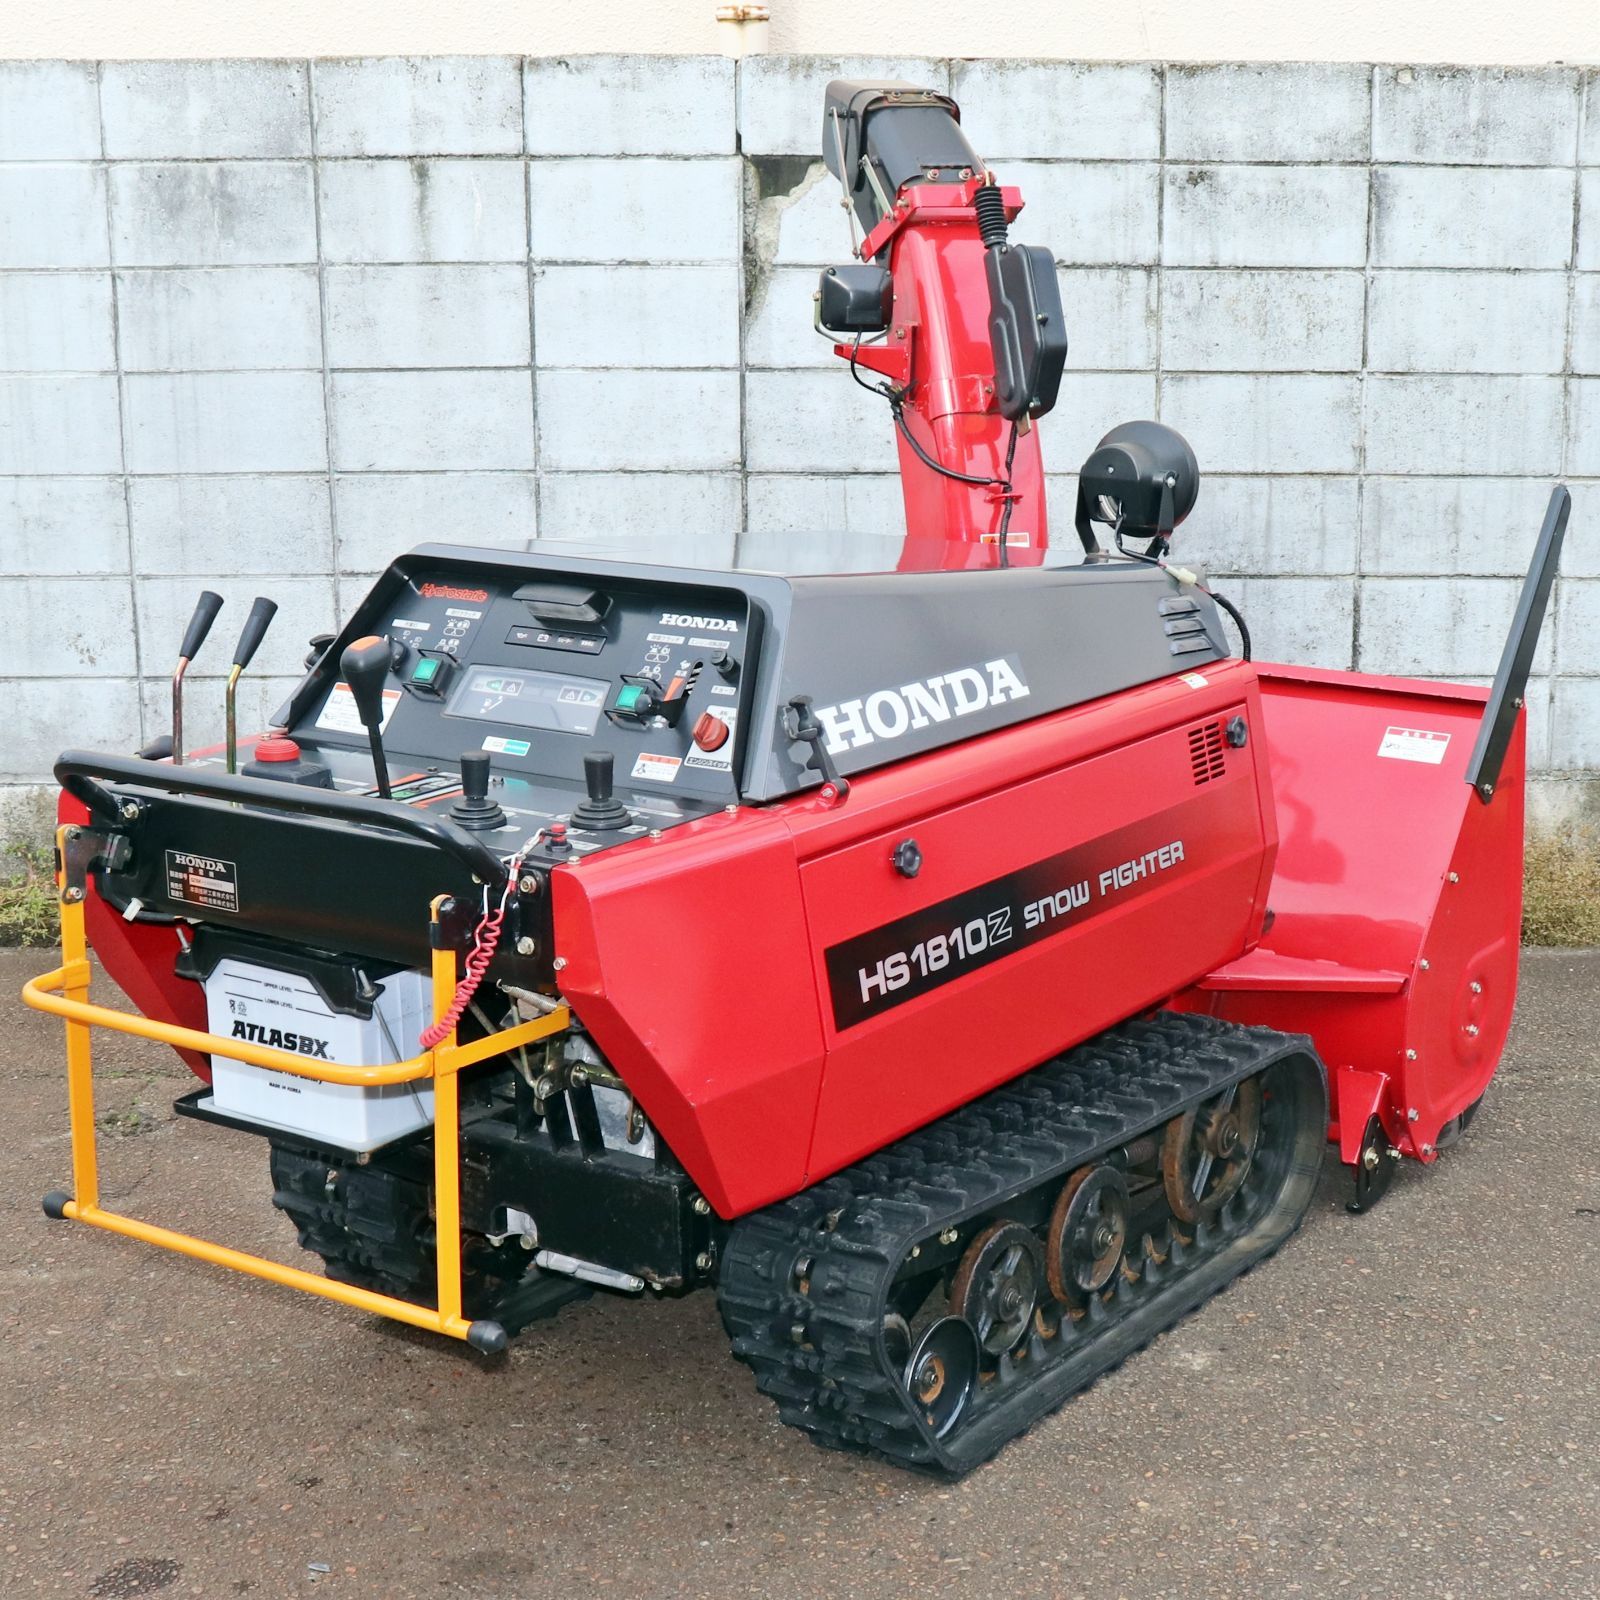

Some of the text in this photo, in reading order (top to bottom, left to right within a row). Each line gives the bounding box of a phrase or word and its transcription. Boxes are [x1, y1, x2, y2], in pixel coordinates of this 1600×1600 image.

[420, 583, 488, 602] Hydrostatic
[659, 613, 739, 632] HONDA
[815, 658, 1030, 755] HONDA
[175, 854, 227, 873] HONDA
[858, 906, 1013, 1003] HS1810Z
[1098, 840, 1185, 896] FIGHTER
[263, 981, 293, 993] UPPER LEVEL
[264, 998, 294, 1009] LOWER LEVEL
[231, 1019, 329, 1059] ATLASBX
